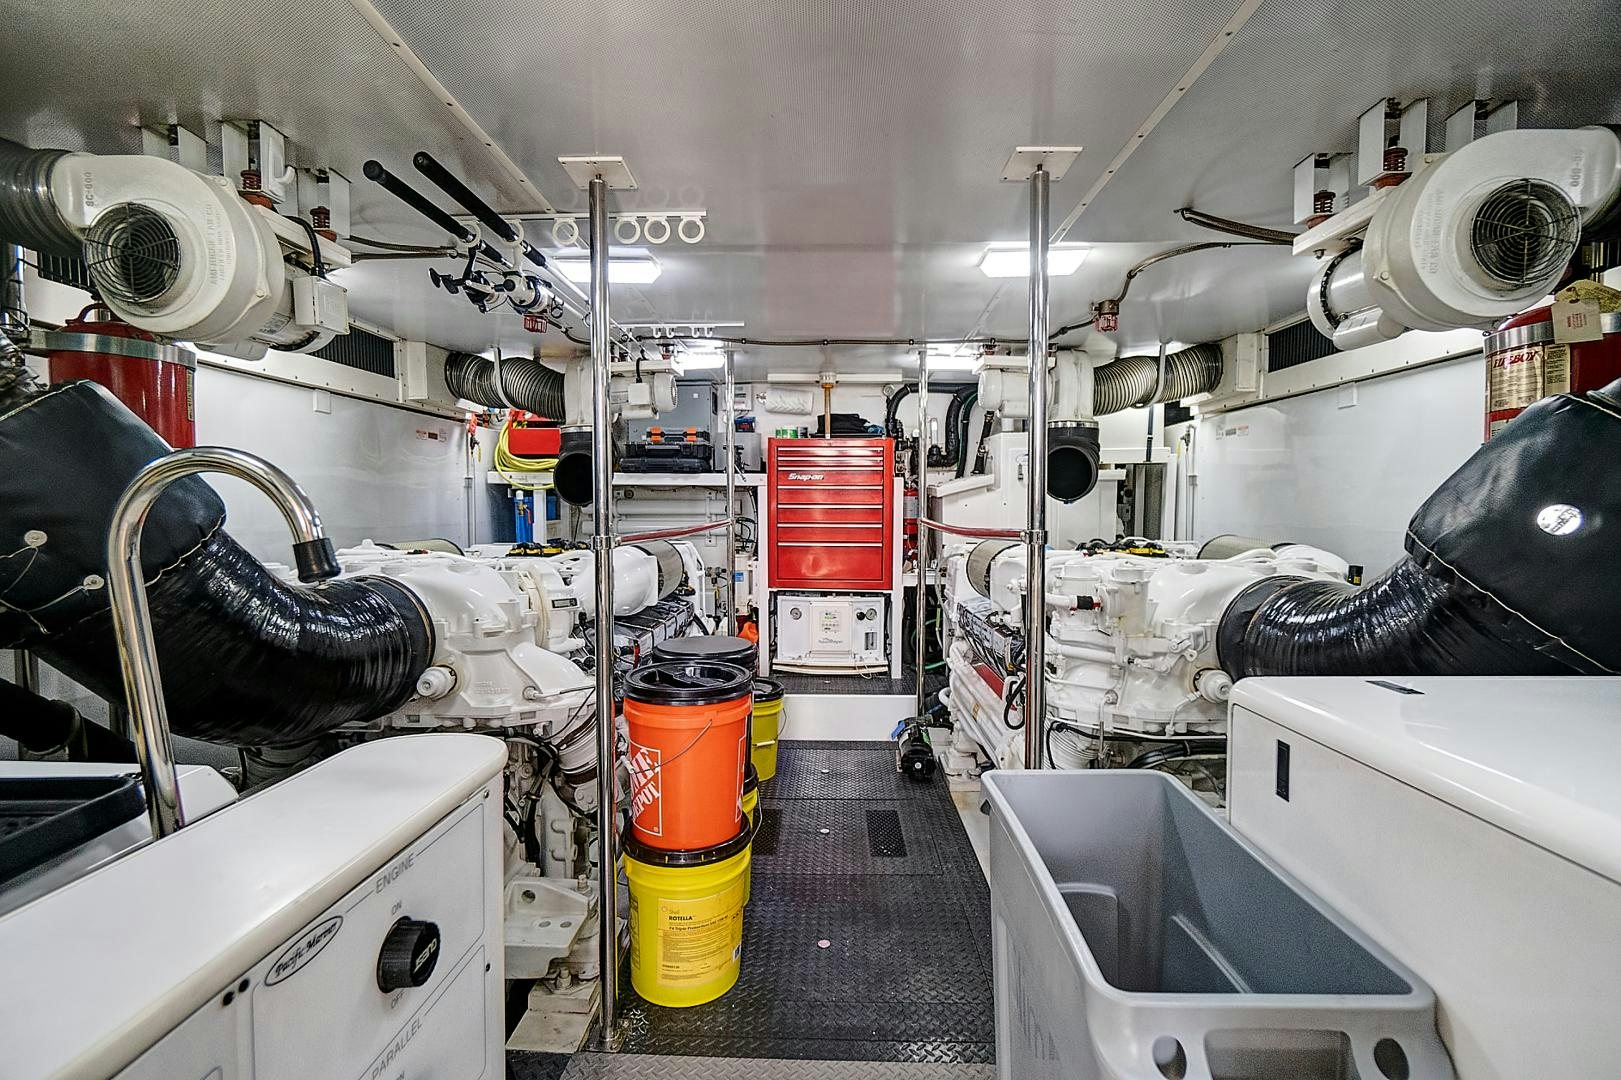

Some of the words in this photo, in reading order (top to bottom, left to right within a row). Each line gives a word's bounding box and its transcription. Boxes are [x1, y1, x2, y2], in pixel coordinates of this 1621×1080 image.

[788, 473, 824, 481] Snap-on
[376, 852, 414, 894] ENGINE
[391, 900, 402, 916] ON
[391, 988, 404, 1009] OFF
[372, 1017, 422, 1080] PARALLEL
